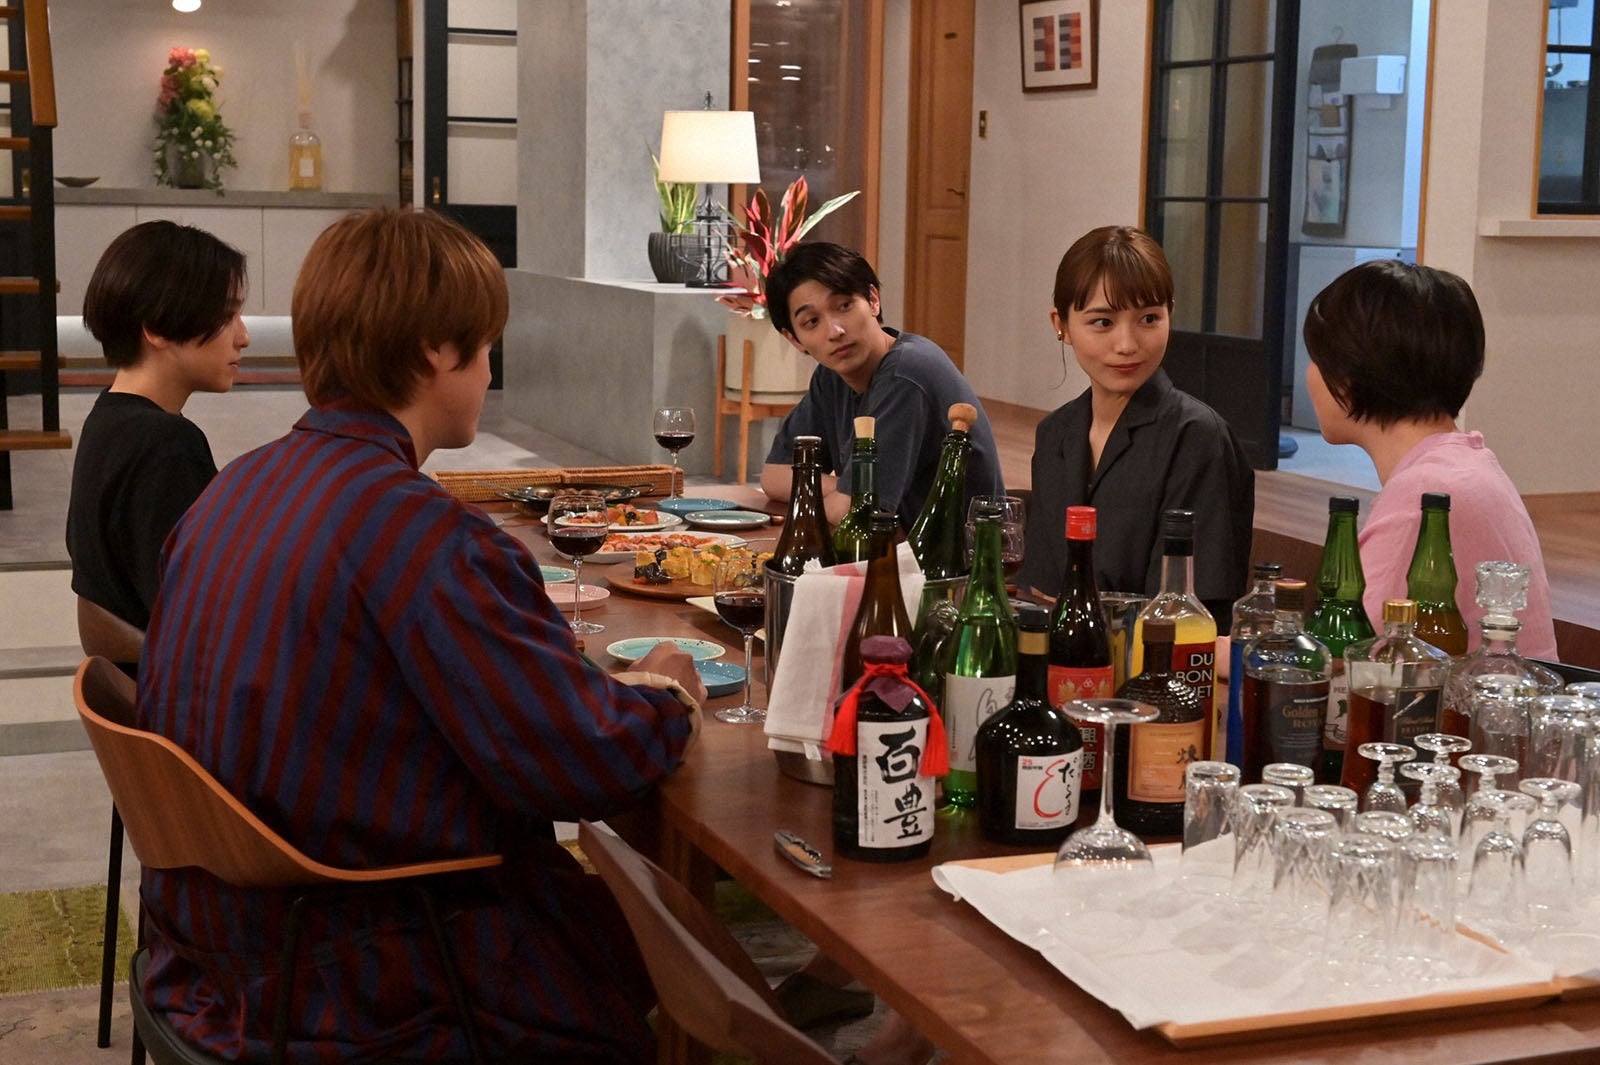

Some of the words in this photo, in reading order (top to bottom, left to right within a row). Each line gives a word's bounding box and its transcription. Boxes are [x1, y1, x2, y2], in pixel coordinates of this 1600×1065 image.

[1190, 653, 1214, 667] DU
[1175, 669, 1213, 683] BON
[1190, 684, 1213, 698] ET
